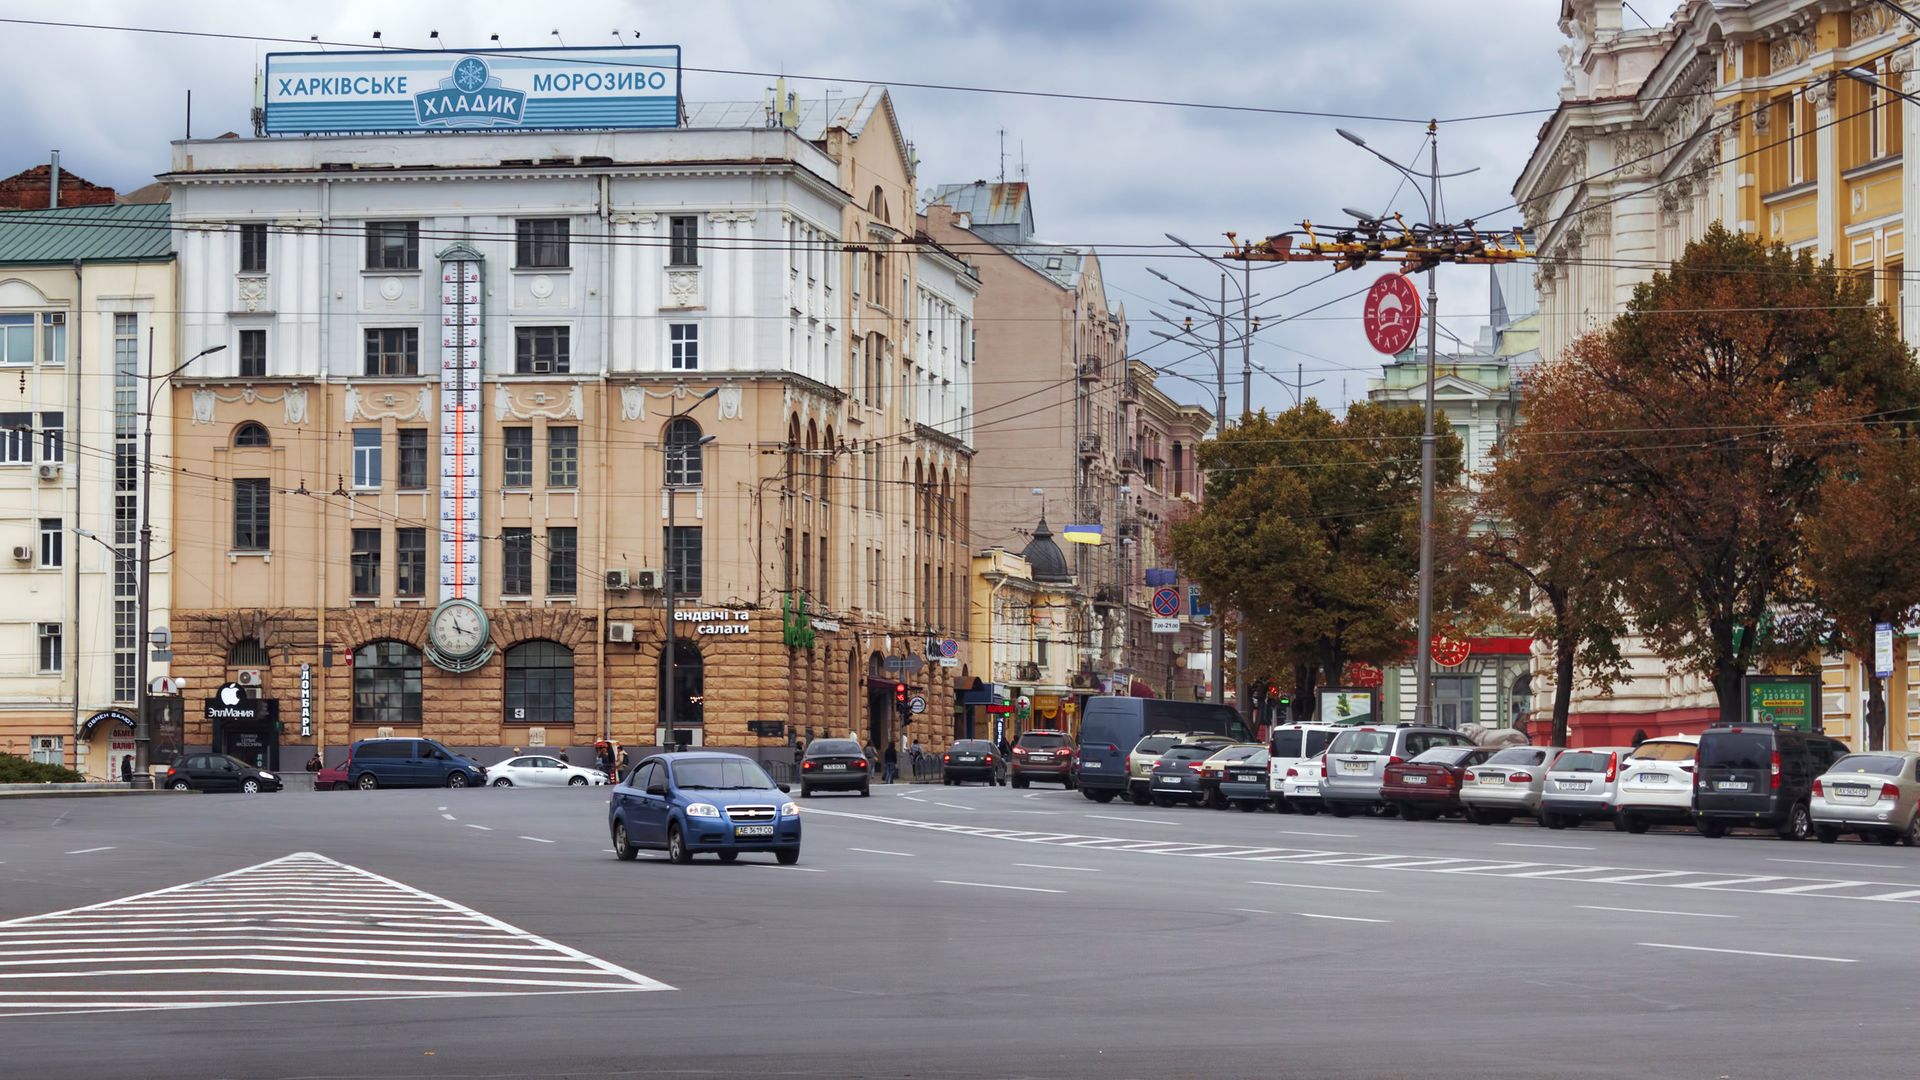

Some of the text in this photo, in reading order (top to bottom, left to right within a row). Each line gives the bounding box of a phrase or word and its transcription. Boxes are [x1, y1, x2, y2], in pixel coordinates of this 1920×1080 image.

[279, 76, 407, 96] ХАРКІВСЬКЕ
[533, 71, 666, 92] МОРОЗИВО
[423, 95, 517, 116] ХЛАДИК
[1367, 279, 1412, 319] ПУЗАТА
[1374, 327, 1408, 348] ХАТА
[674, 609, 749, 622] ендвічі та
[697, 624, 750, 634] салати
[208, 708, 254, 718] ЭплМания
[302, 670, 310, 736] ЛОМБАРД
[87, 712, 134, 728] ОБМЕН ВАЛЮТ
